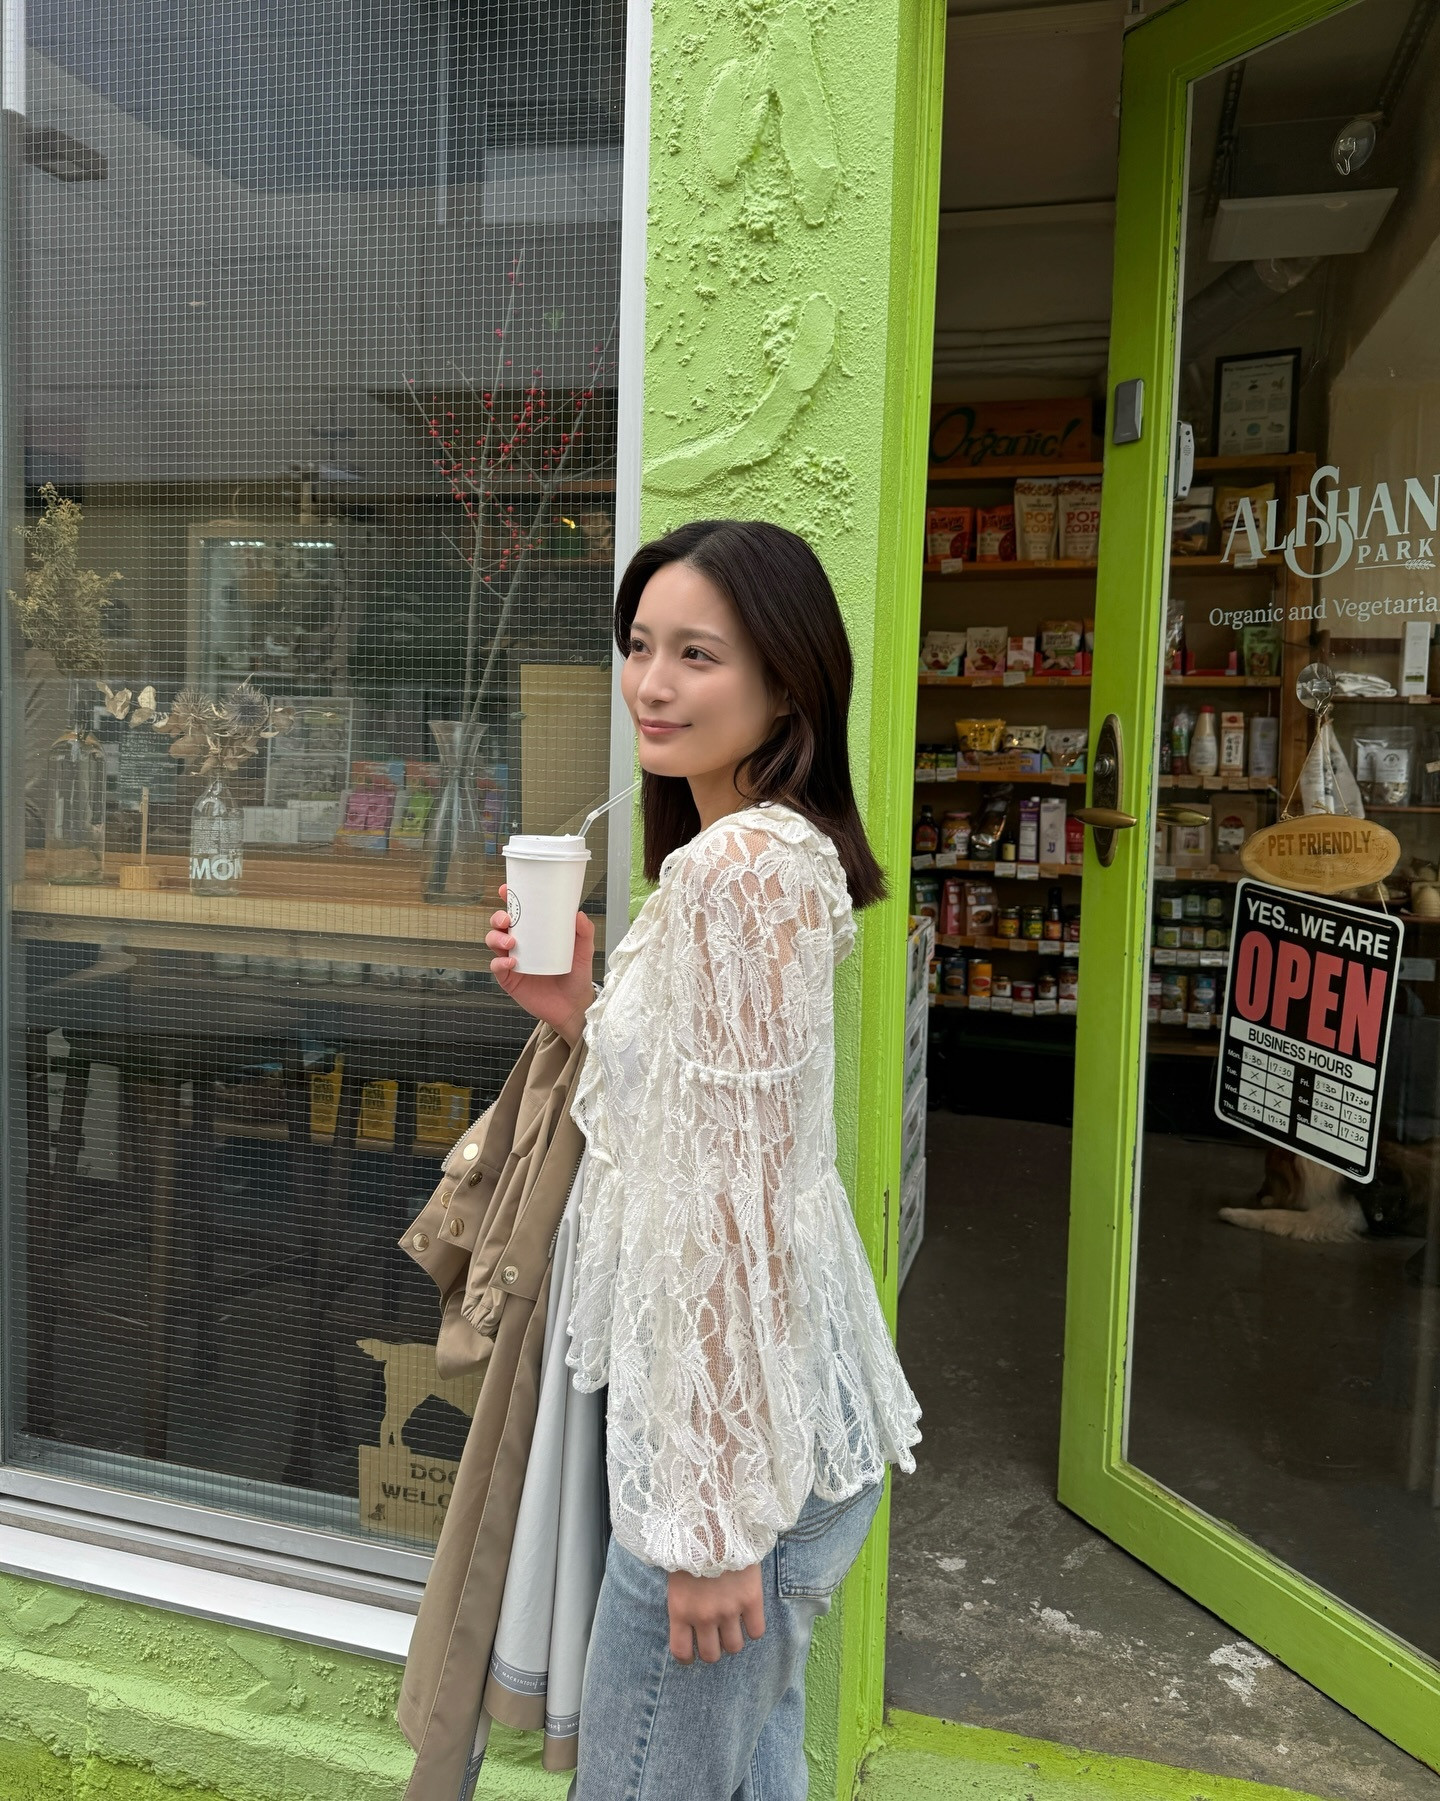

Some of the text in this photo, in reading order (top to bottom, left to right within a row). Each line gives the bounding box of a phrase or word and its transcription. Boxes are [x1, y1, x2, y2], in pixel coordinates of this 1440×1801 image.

[931, 406, 1081, 466] Organic!
[1065, 511, 1100, 524] POP
[1357, 538, 1434, 564] PARK
[1209, 602, 1284, 630] Organic
[1288, 597, 1328, 621] and
[1268, 830, 1372, 857] PET FRIENDLY
[1300, 913, 1337, 945] WE
[1337, 925, 1391, 960] ARE
[1235, 930, 1388, 1064] OPEN
[1248, 1027, 1353, 1079] BUSINESS HOURS
[1269, 1061, 1292, 1078] 17:30
[1343, 1108, 1368, 1124] 17:30
[1340, 1126, 1365, 1142] 17:30
